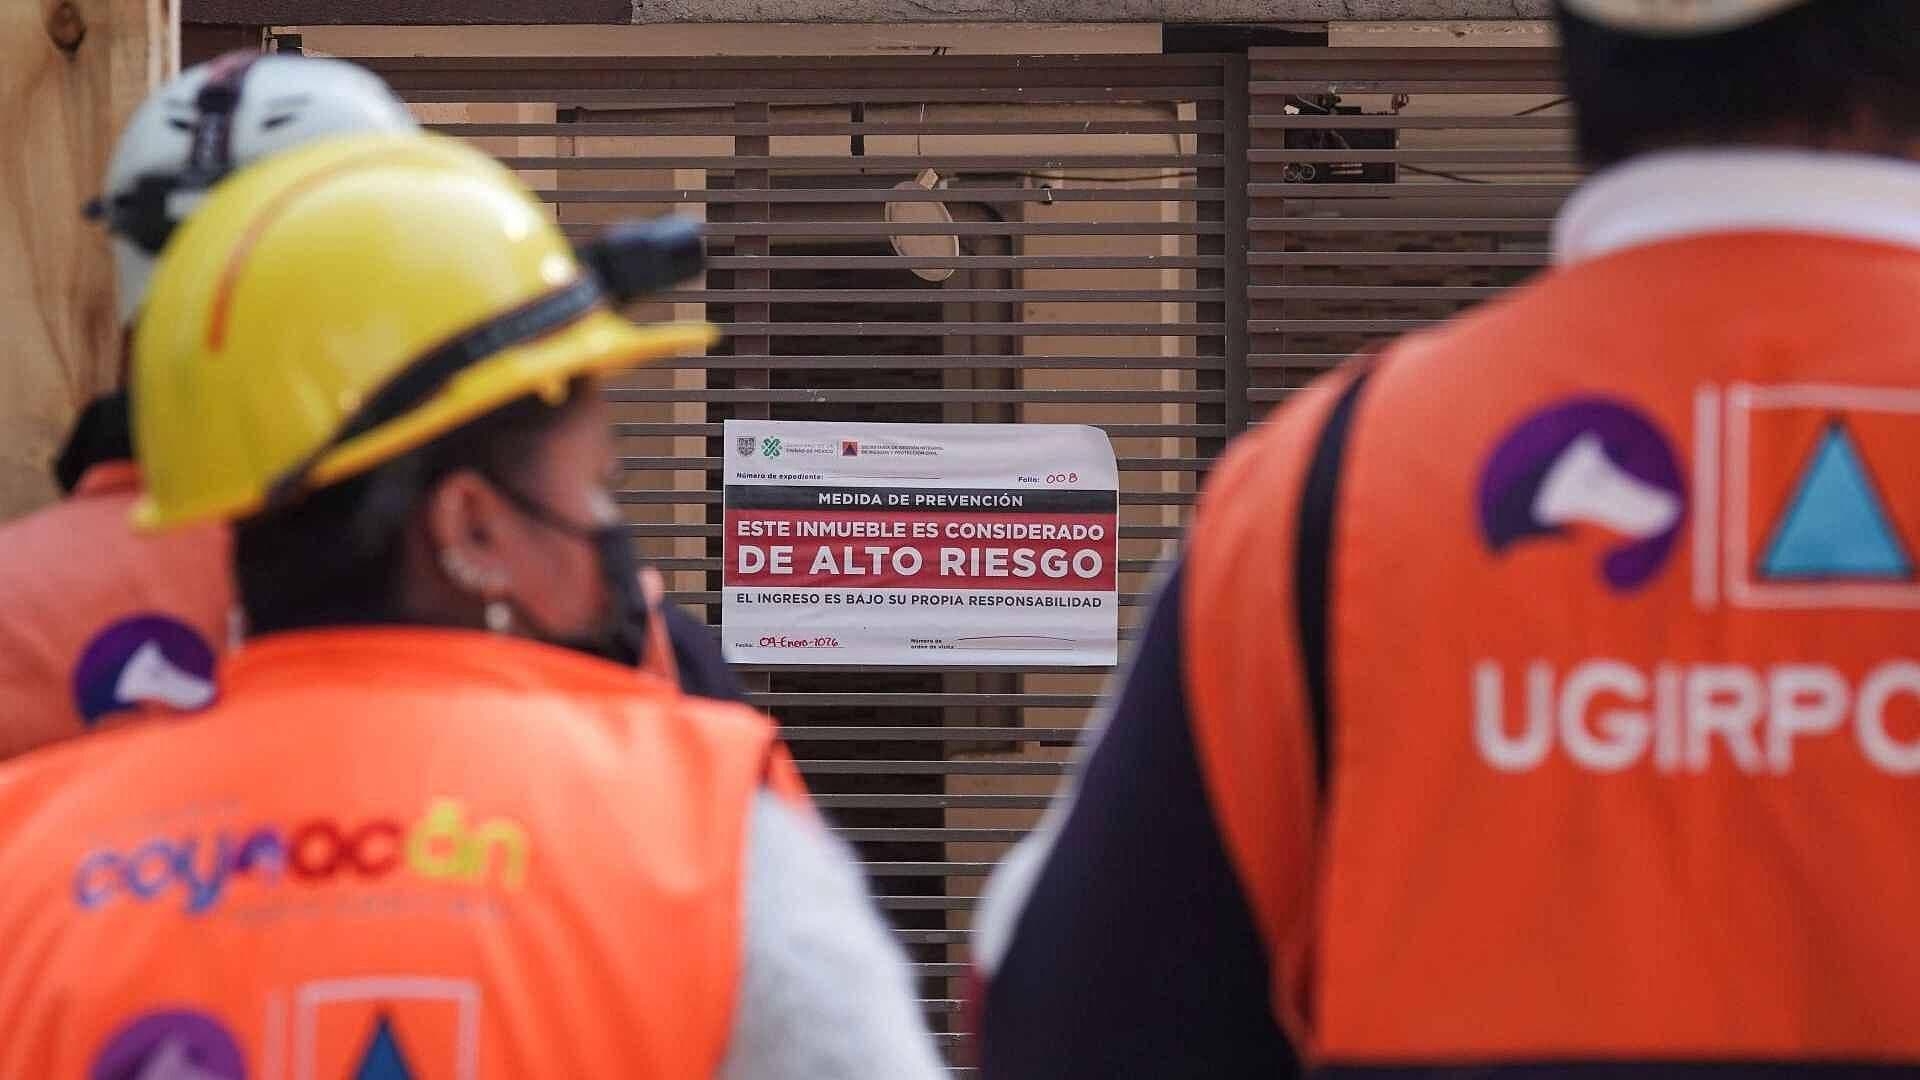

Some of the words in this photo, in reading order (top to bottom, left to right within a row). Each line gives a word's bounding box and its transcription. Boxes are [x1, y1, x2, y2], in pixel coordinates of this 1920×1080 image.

[736, 472, 765, 480] Número
[767, 472, 777, 480] de
[778, 472, 824, 481] expediente:
[1018, 475, 1040, 483] Folio:
[818, 493, 882, 505] MEDIDA
[888, 494, 910, 506] DE
[916, 492, 1023, 507] PREVENCIÓN
[737, 520, 790, 537] ESTE
[796, 521, 906, 538] INMUEBLE
[912, 522, 939, 538] ES
[945, 523, 1105, 541] CONSIDERADO
[738, 545, 793, 574] DE
[809, 545, 923, 576] ALTO
[940, 547, 1103, 579] RIESGO
[736, 593, 752, 604] EL
[758, 593, 820, 604] INGRESO
[824, 593, 841, 604] ES
[846, 594, 884, 605] BAJO
[888, 594, 906, 605] SU
[911, 594, 964, 606] PROPIA
[968, 595, 1102, 608] RESPONSABILIDAD
